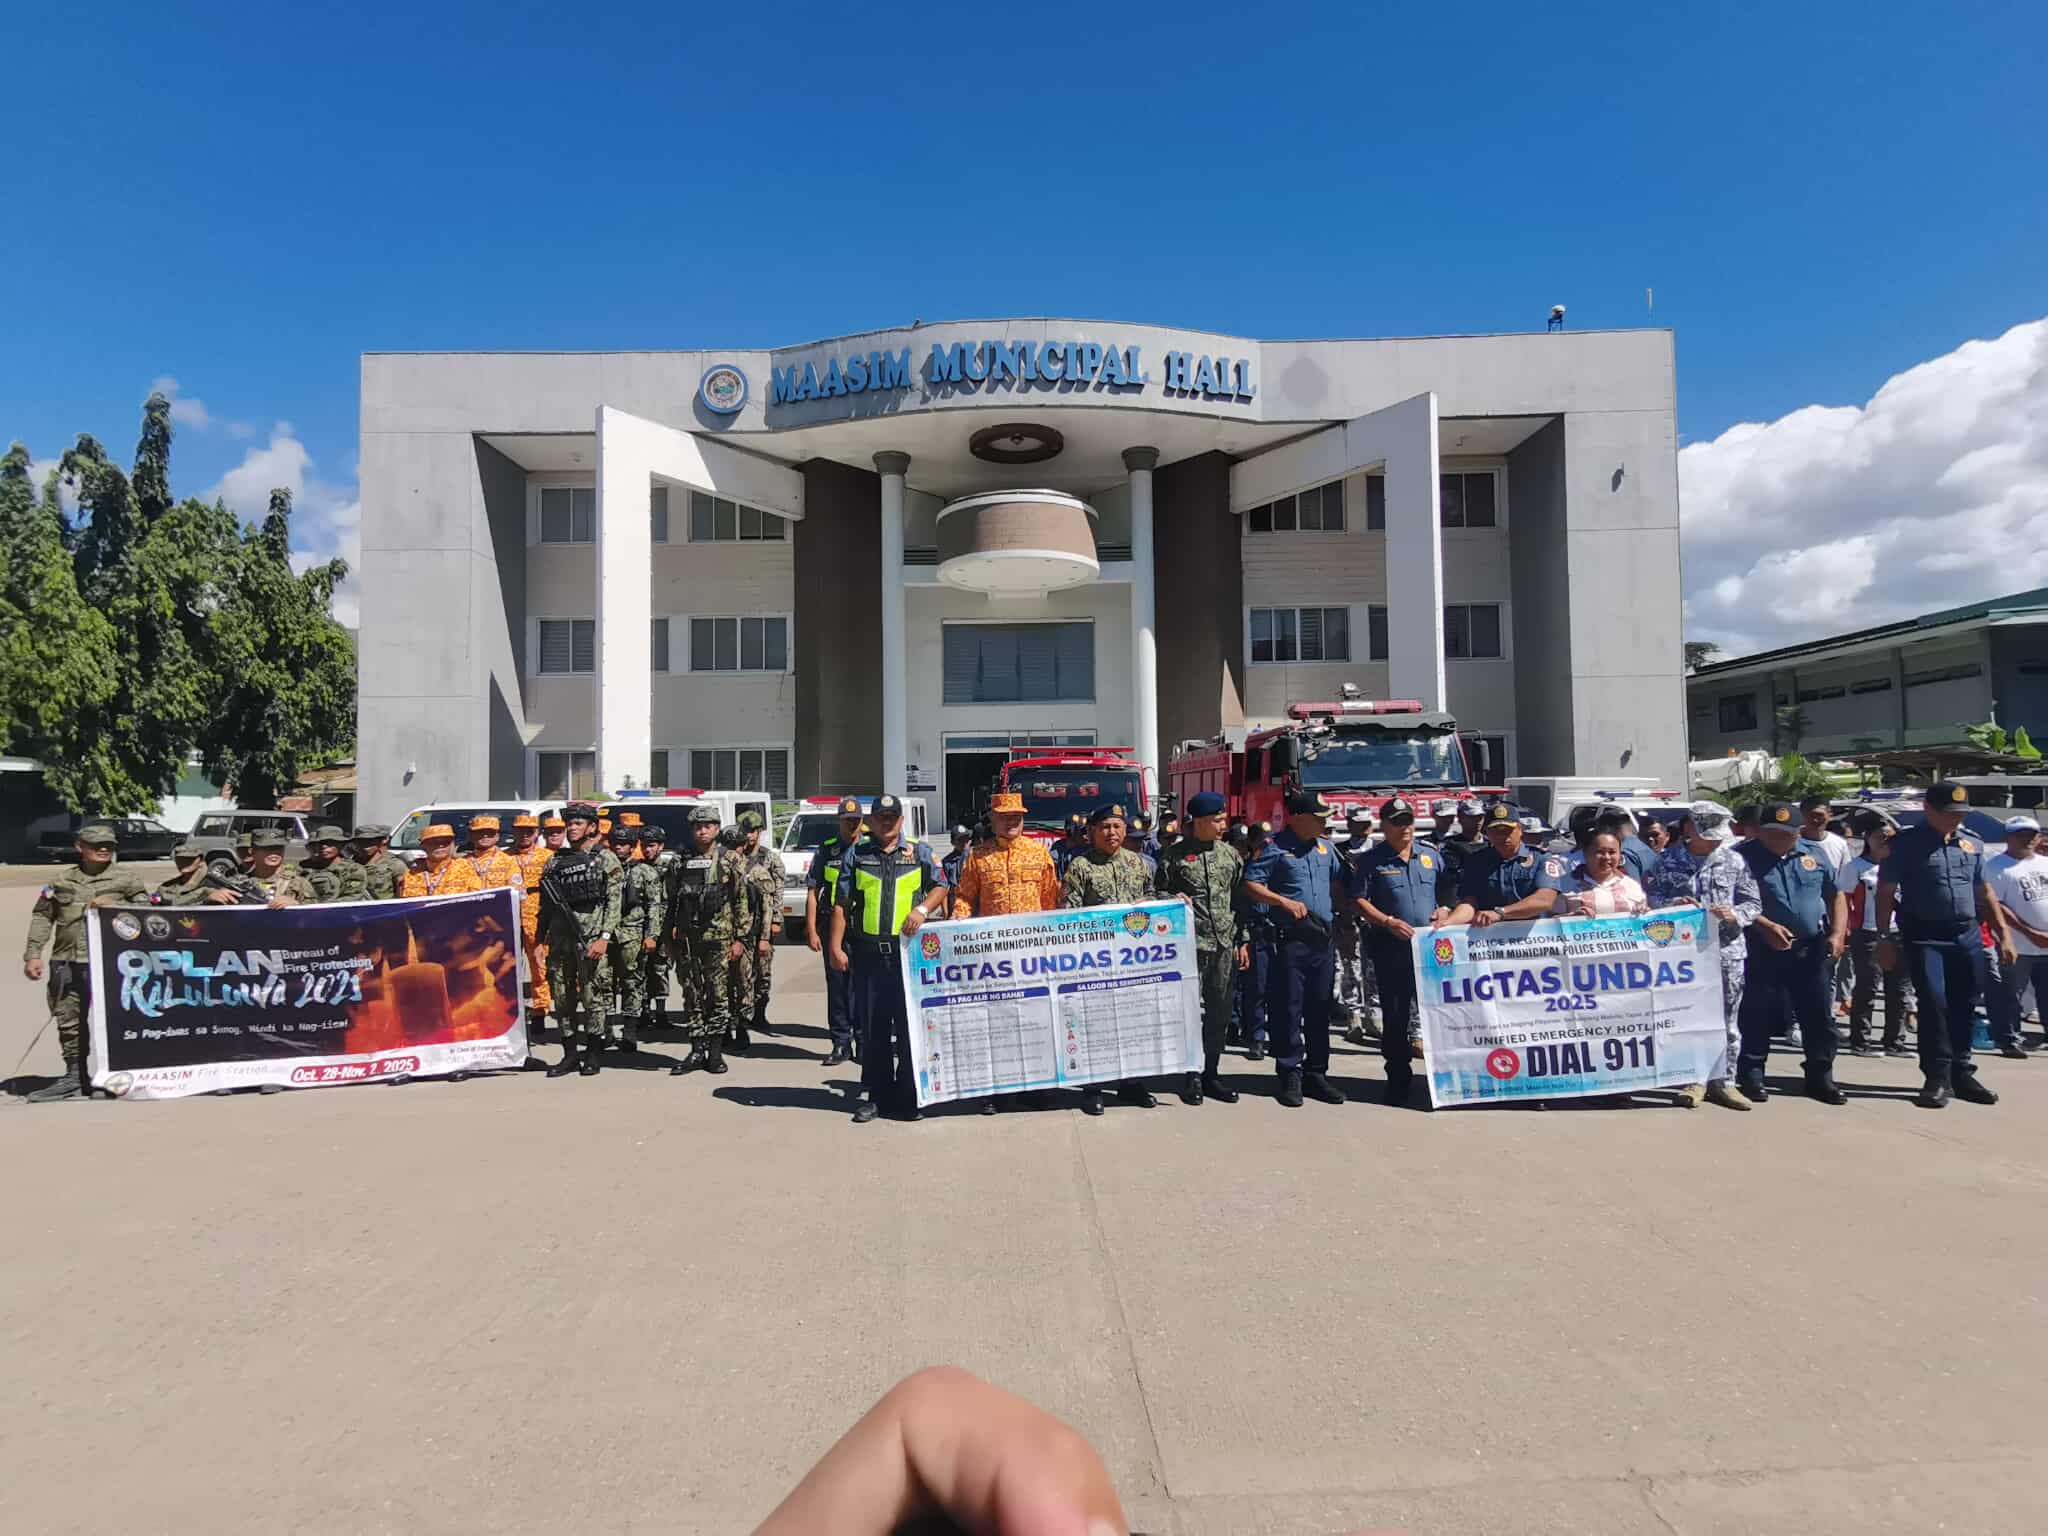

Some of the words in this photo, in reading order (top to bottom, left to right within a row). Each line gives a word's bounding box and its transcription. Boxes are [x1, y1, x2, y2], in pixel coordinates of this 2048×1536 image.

[770, 347, 911, 404] MAASIM
[930, 340, 1149, 386] MUNICIPAL
[1166, 350, 1256, 397] HALL
[953, 931, 993, 942] POLICE
[998, 927, 1054, 938] REGIONAL
[1058, 921, 1097, 931] OFFICE
[1102, 919, 1113, 927] 12
[1468, 938, 1504, 949] POLICE
[1509, 934, 1570, 946] REGIONAL
[1573, 931, 1617, 942] OFFICE
[1621, 929, 1634, 937] 12
[281, 949, 324, 960] Bureau
[328, 945, 340, 956] of
[954, 943, 992, 955] MAASIM
[994, 937, 1043, 952] MUNICIPAL
[1046, 933, 1077, 946] POLICE
[1078, 930, 1115, 942] STATION
[1507, 947, 1560, 959] MUNICIPAL
[1563, 944, 1599, 956] POLICE
[1599, 941, 1638, 952] STATION
[117, 949, 284, 977] OPLAN
[284, 964, 308, 974] Fire
[311, 957, 372, 971] Protection
[920, 960, 1012, 985] LIGTAS
[1021, 950, 1112, 976] UNDAS
[1120, 943, 1177, 966] 2025
[1442, 966, 1562, 1004] LIGTAS
[1572, 960, 1695, 992] UNDAS
[1545, 995, 1598, 1012] 2025
[1473, 1034, 1527, 1046] UNIFIED
[1531, 1027, 1611, 1041] EMERGENCY
[1617, 1019, 1676, 1034] HOTLINE:
[1527, 1043, 1597, 1077] DIAL
[1604, 1036, 1656, 1071] 911
[138, 1071, 192, 1081] MAASIM
[294, 1069, 317, 1081] Oct.
[321, 1066, 366, 1080] 28-Nov.
[384, 1059, 414, 1072] 2025
